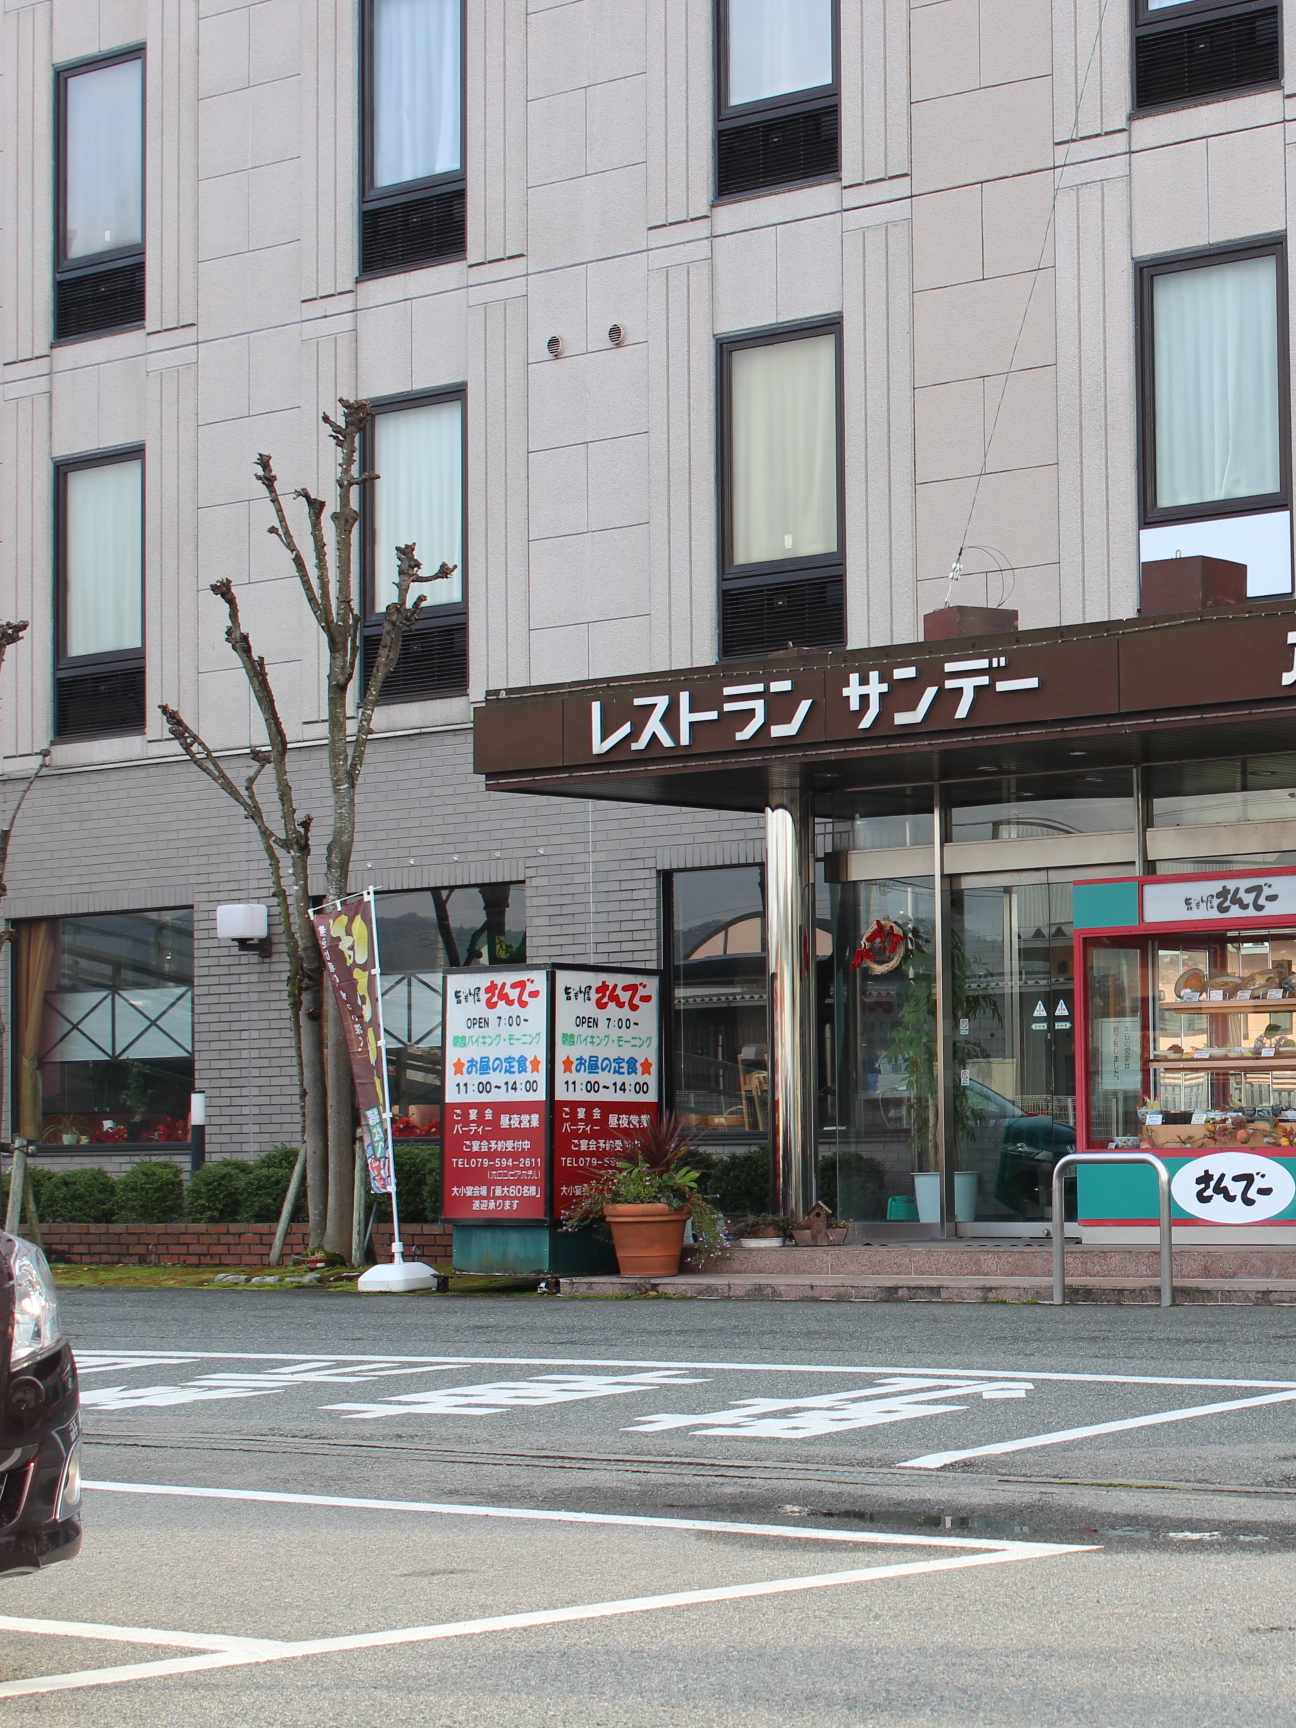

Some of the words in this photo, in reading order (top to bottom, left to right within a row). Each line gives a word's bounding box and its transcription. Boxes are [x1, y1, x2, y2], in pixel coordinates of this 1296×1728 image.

[591, 680, 813, 755] レストラン
[842, 656, 1041, 730] サンデー
[1216, 882, 1279, 914] さんでー
[484, 978, 540, 1009] さんでー
[595, 980, 652, 1012] さんでー
[466, 1016, 489, 1029] OPEN
[575, 1016, 599, 1028] OPEN
[466, 1055, 528, 1076] お昼の定食
[575, 1055, 639, 1076] お昼の定食
[500, 1113, 540, 1128] 昼夜営業
[463, 1140, 531, 1152] ご宴会予約受付中
[452, 1158, 541, 1168] TEL079-594-2611
[1195, 1169, 1273, 1206] さんでー
[472, 1199, 519, 1211] 送迎承ります
